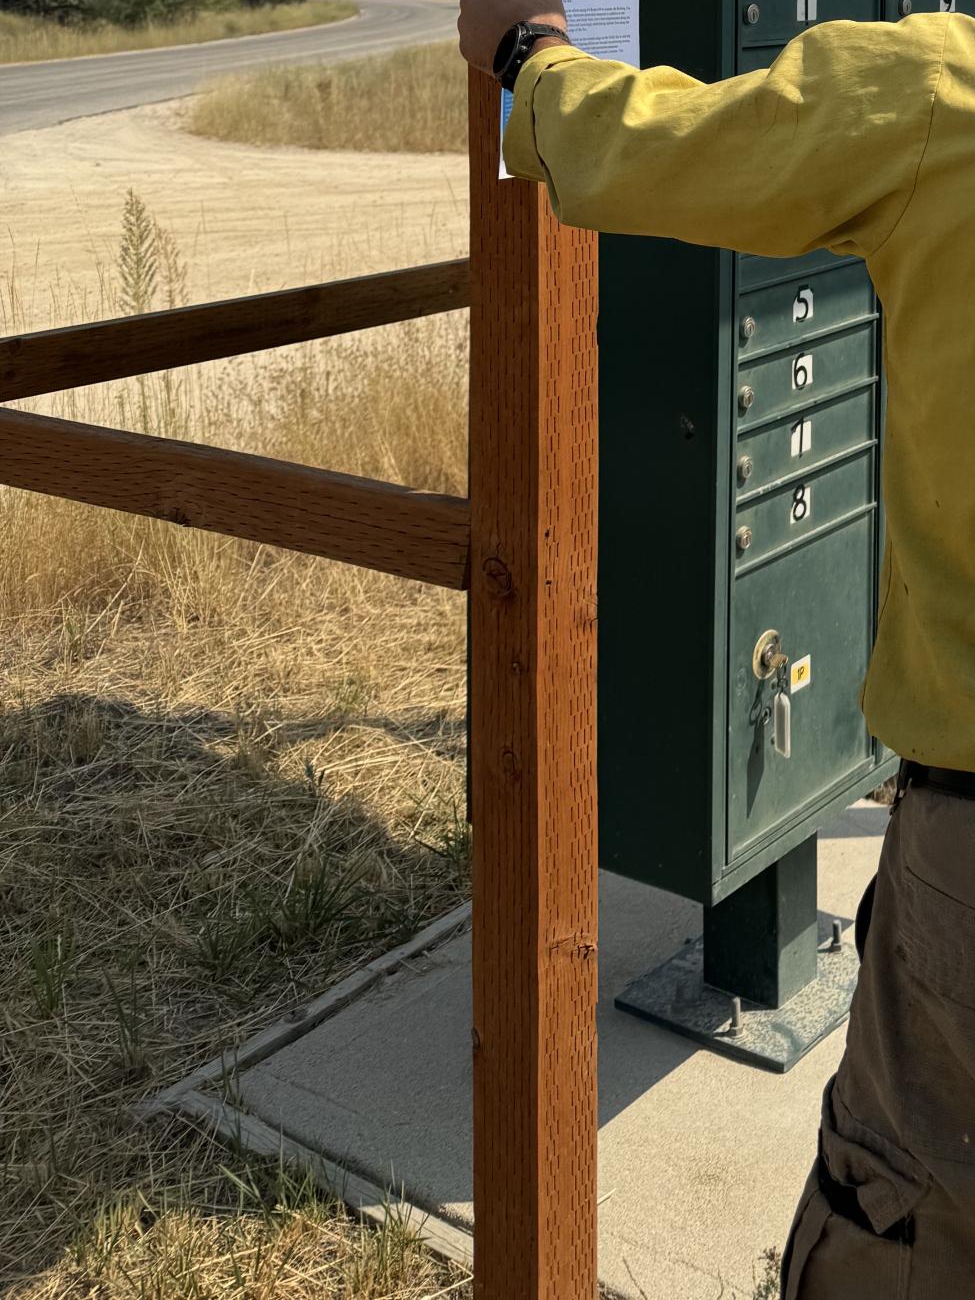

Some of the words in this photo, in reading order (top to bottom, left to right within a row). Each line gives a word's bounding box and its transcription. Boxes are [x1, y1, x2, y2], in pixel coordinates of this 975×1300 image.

[795, 284, 813, 322] 5
[793, 352, 807, 390] 6
[793, 484, 806, 521] 8
[797, 666, 805, 681] 1P
